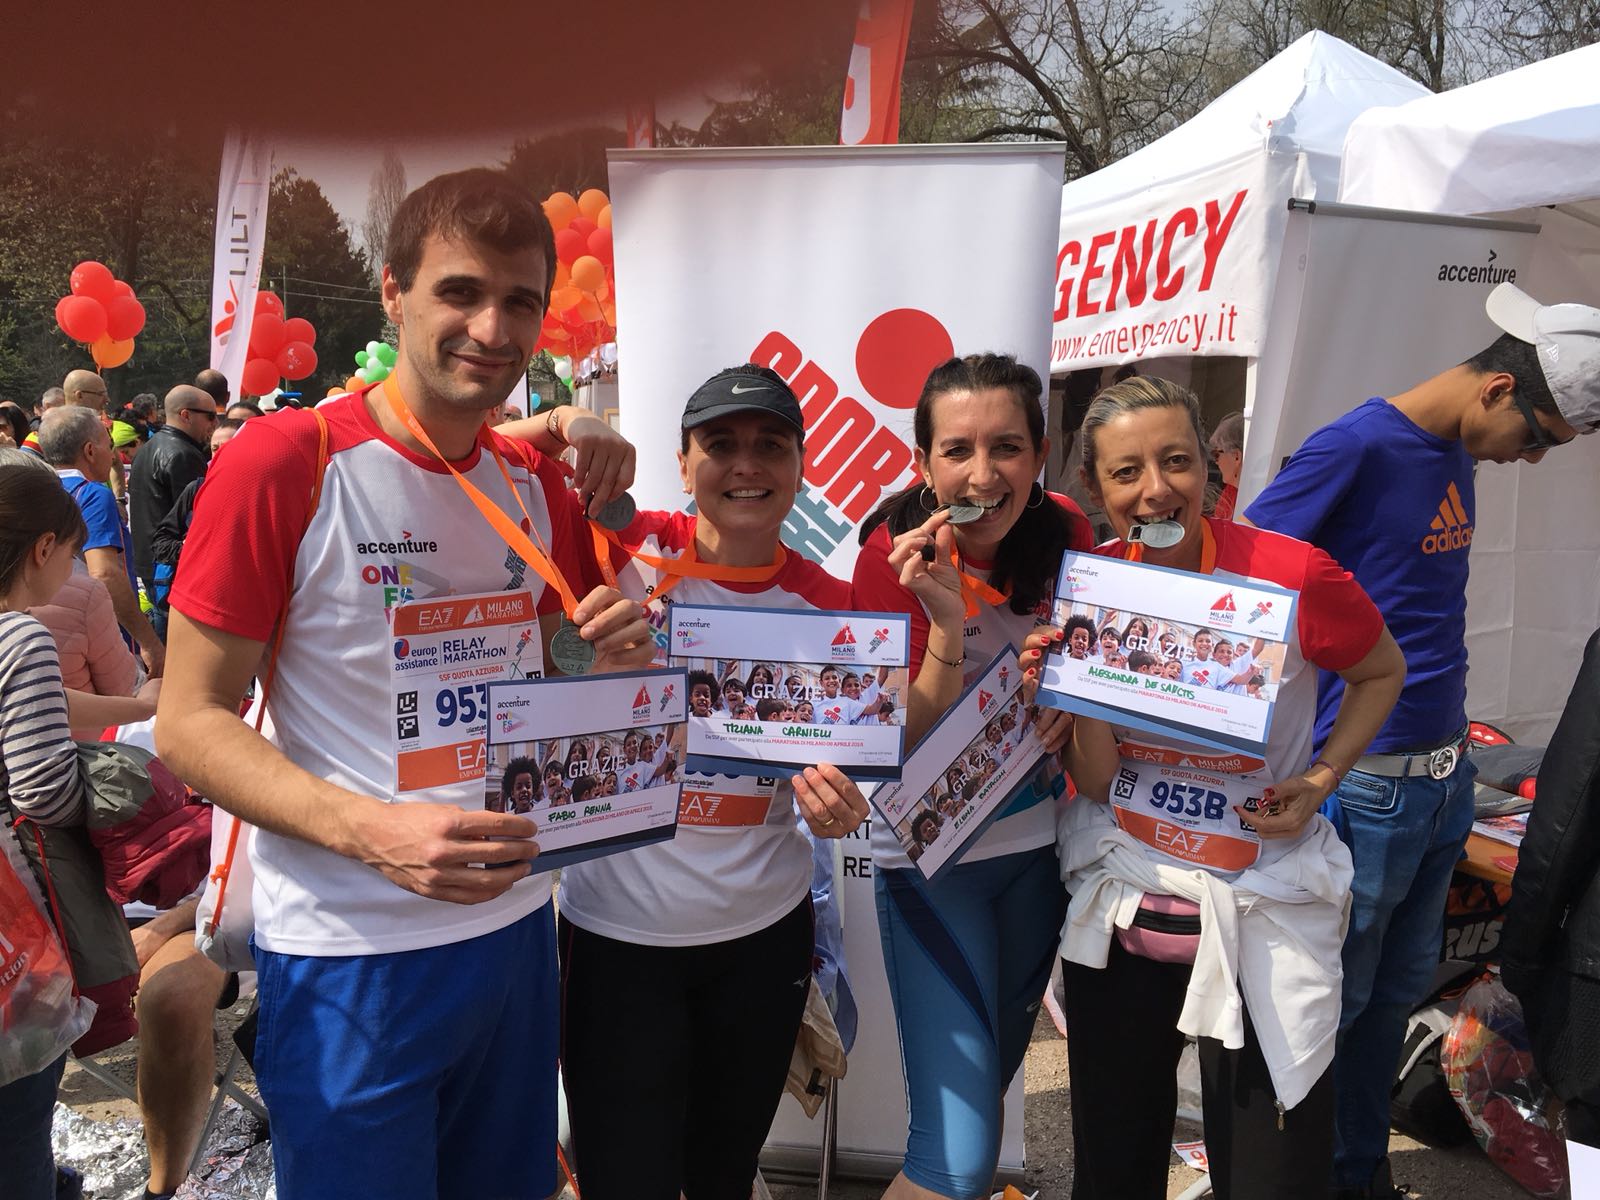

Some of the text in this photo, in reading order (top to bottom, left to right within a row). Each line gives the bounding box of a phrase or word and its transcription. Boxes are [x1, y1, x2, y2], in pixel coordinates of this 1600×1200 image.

[229, 206, 249, 276] LILT
[1437, 262, 1517, 284] accenture
[750, 331, 927, 525] SPOR
[356, 539, 438, 555] accenture
[1421, 523, 1474, 555] adidas
[362, 565, 414, 586] ONE
[1070, 568, 1099, 577] accenture
[418, 600, 523, 626] EA7 MILANO
[1209, 612, 1234, 621] MILANO
[411, 637, 487, 658] europ RELAY
[1126, 634, 1195, 662] GRAZIE
[395, 646, 507, 672] assistance MARATHON
[438, 673, 450, 682] SSF
[451, 671, 474, 680] QUOTA
[475, 665, 505, 676] AZZURRA
[1145, 678, 1158, 689] DE
[751, 683, 824, 701] GRAZIE
[1171, 697, 1190, 707] MILANO
[497, 699, 530, 709] accenture
[568, 756, 624, 779] GRAZIE
[1132, 750, 1241, 767] EA7 MILANO
[1160, 768, 1225, 787] SSF QUOTA AZZURRA
[1149, 781, 1228, 820] 953B
[548, 810, 577, 823] FABIO
[1155, 822, 1209, 854] EA7
